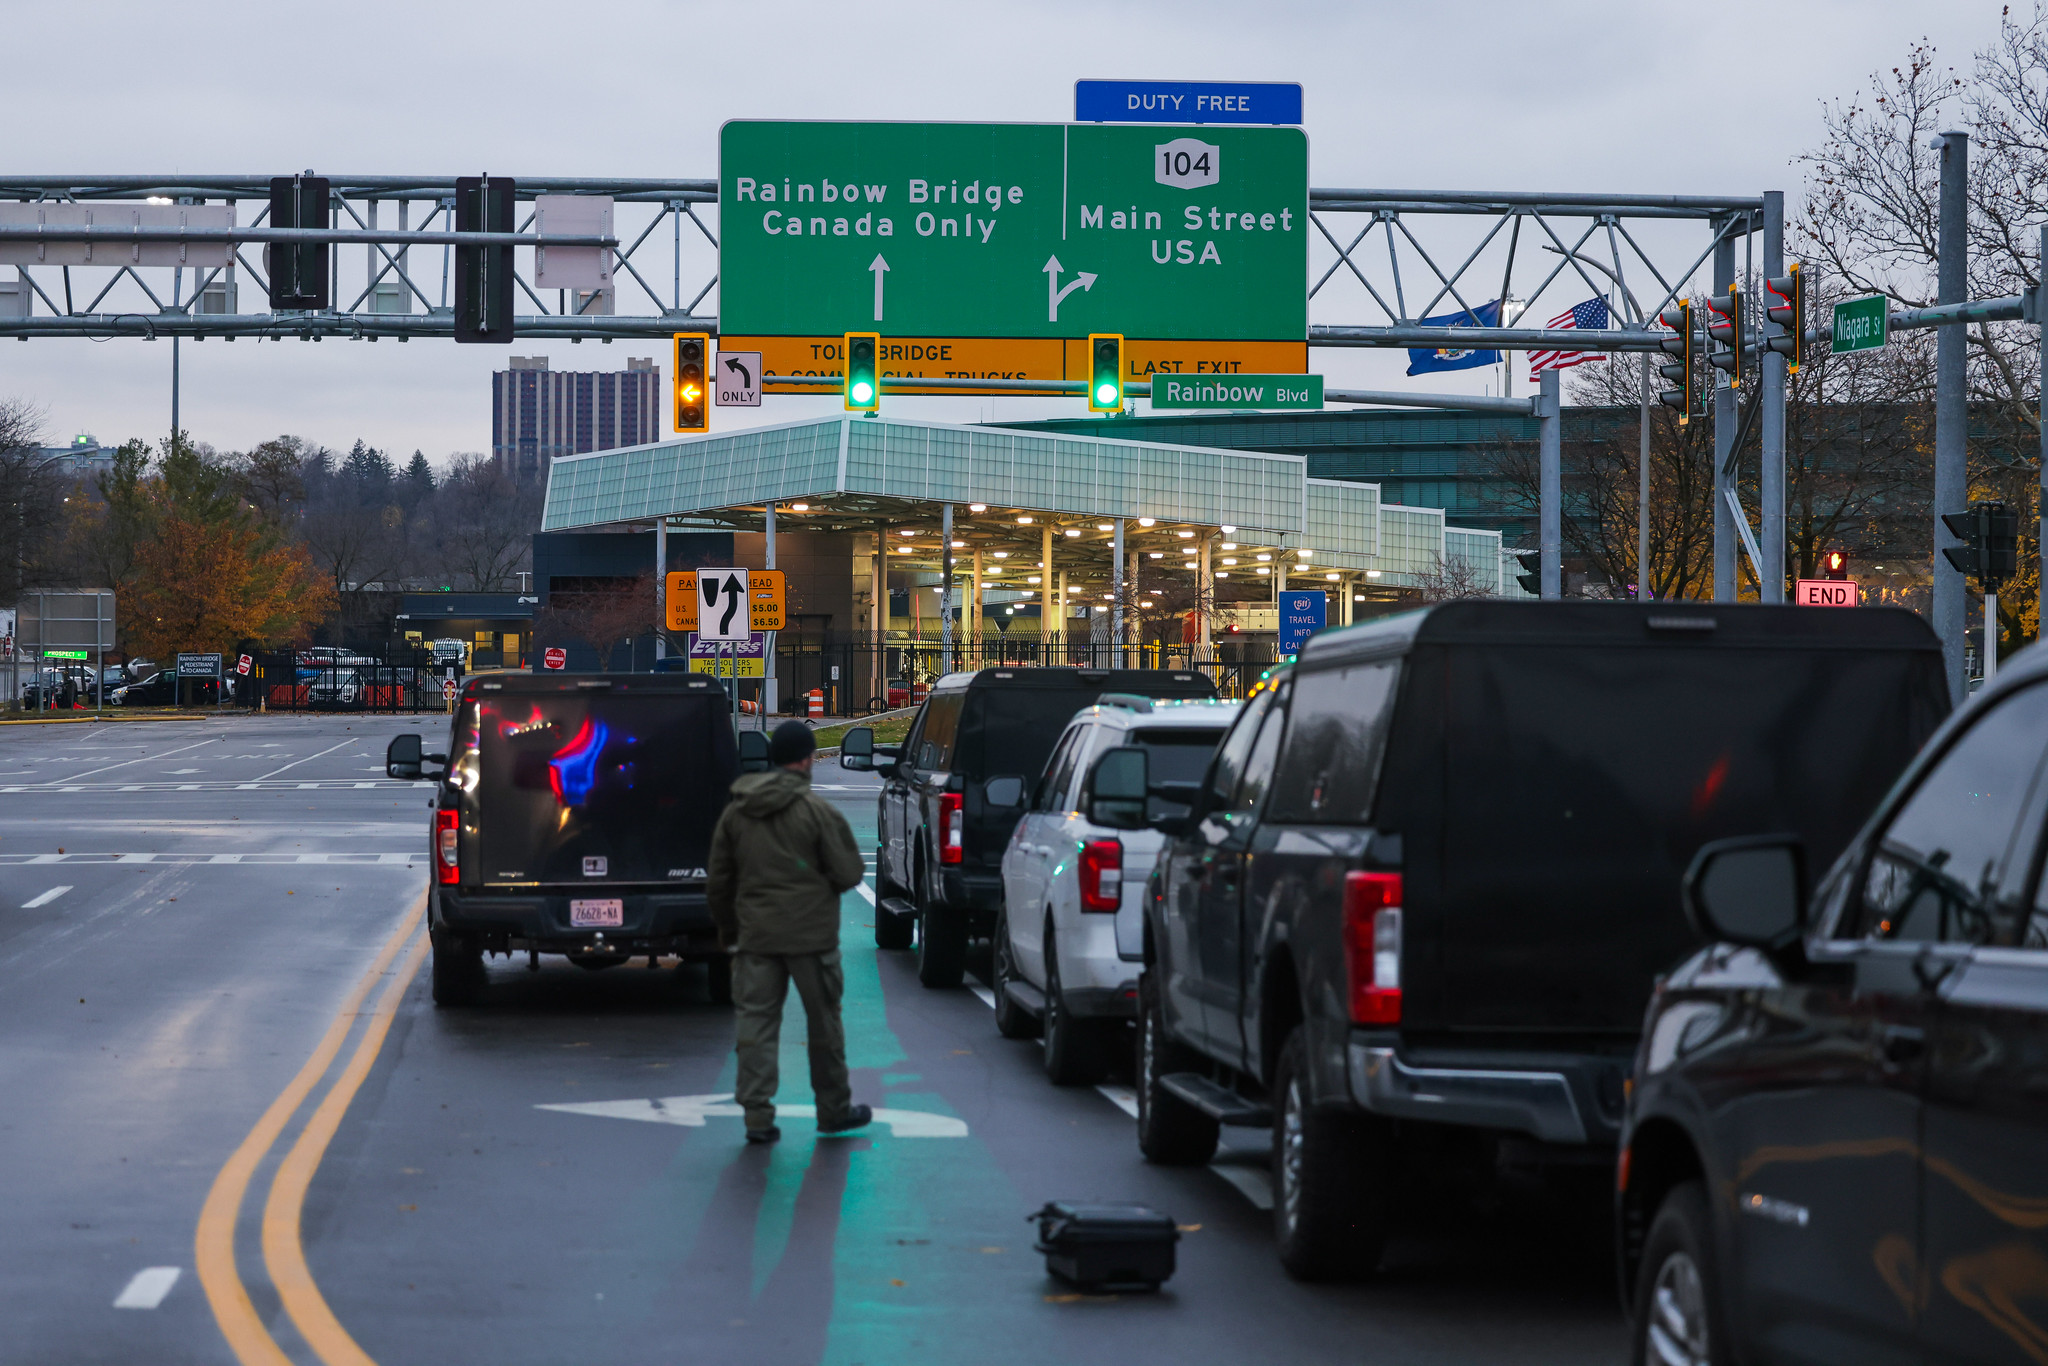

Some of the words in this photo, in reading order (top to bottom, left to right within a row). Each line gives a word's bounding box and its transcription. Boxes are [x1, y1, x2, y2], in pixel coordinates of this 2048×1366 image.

[1127, 94, 1184, 110] DUTY
[1197, 95, 1250, 111] FREE
[1163, 151, 1211, 176] 104
[736, 177, 887, 203] Rainbow
[909, 179, 1024, 212] Bridge
[763, 210, 893, 236] Canada
[916, 213, 997, 243] Only
[1081, 205, 1161, 230] Main
[1184, 205, 1293, 231] Street
[1152, 240, 1221, 264] USA
[1837, 313, 1870, 348] Niagara
[1874, 316, 1880, 335] St
[810, 345, 844, 360] TOL
[880, 345, 952, 360] BRIDGE
[1131, 361, 1183, 375] LAST
[1198, 361, 1242, 374] EXIT
[722, 391, 755, 402] ONLY
[1167, 382, 1264, 402] Rainbow
[1277, 389, 1309, 402] Blvd
[679, 580, 697, 588] PAY
[749, 579, 773, 587] HEAD
[1809, 587, 1846, 604] END
[752, 604, 778, 612] $5.00
[676, 617, 698, 625] CANAD
[753, 617, 779, 626] $6.50
[1285, 641, 1303, 649] CAL
